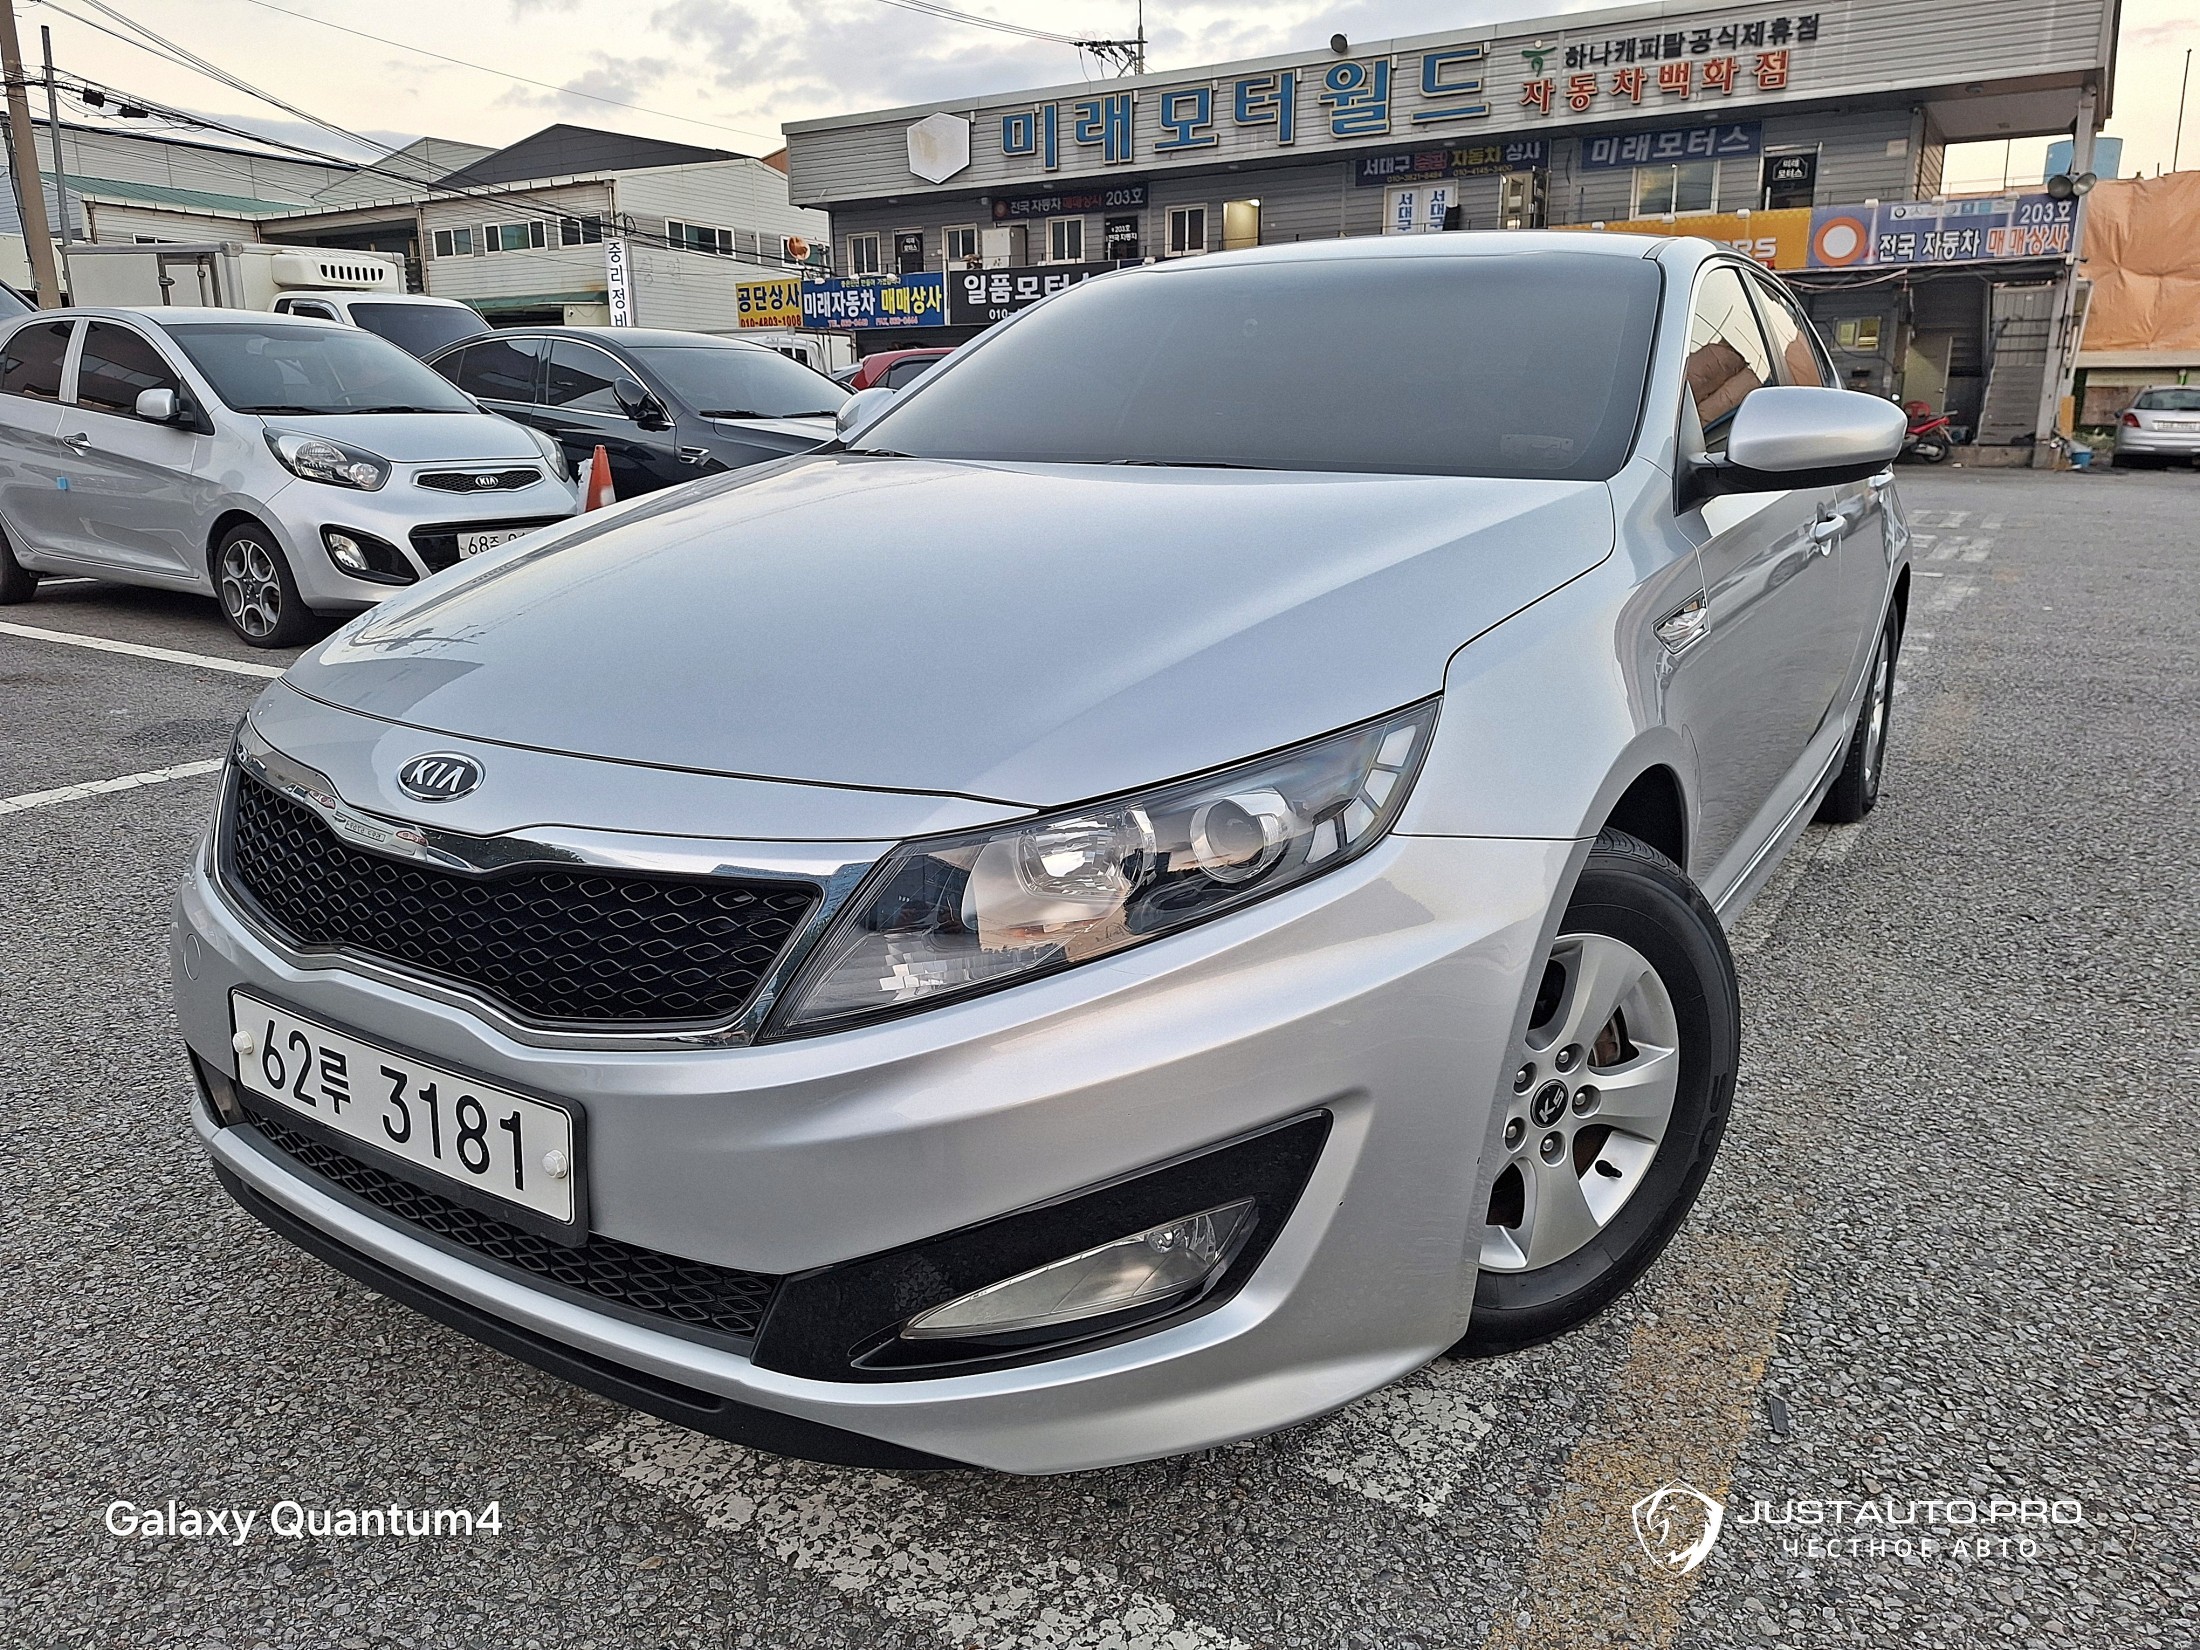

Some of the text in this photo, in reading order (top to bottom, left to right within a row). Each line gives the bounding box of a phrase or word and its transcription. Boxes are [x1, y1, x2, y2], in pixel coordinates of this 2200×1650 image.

[1520, 50, 1789, 115] 자동차백화점
[1000, 45, 1490, 171] 미래모터월드
[1363, 155, 1410, 176] 서대구
[1506, 142, 1540, 162] 상사
[1591, 126, 1749, 165] 미래모터스
[1105, 187, 1144, 206] 203호
[2020, 200, 2072, 225] 203호
[1879, 233, 1917, 262] 전국
[1922, 229, 1981, 261] 자동차
[737, 283, 800, 312] 공단상사
[803, 285, 942, 319] 미래자동차 매매상사
[406, 759, 465, 792] KIA
[261, 1019, 525, 1191] 62루 3181
